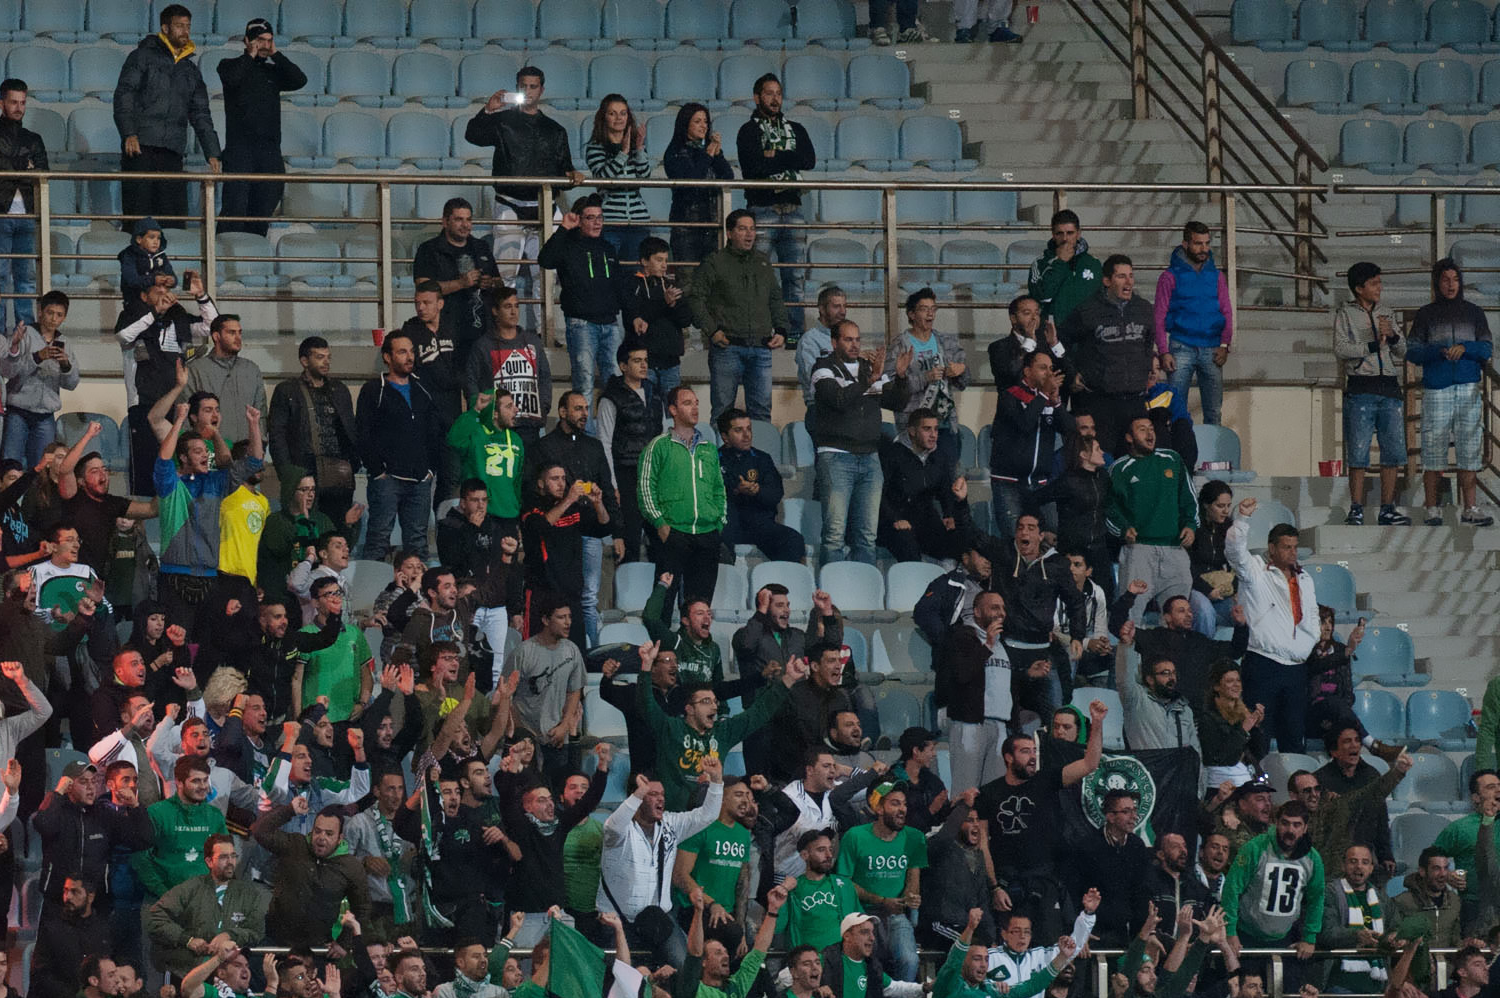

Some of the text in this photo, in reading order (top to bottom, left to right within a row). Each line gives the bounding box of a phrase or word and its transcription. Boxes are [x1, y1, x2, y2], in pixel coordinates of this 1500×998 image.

[505, 360, 528, 375] QUIT
[715, 839, 746, 858] 1966
[867, 854, 908, 870] 1966
[1265, 866, 1300, 913] 13
